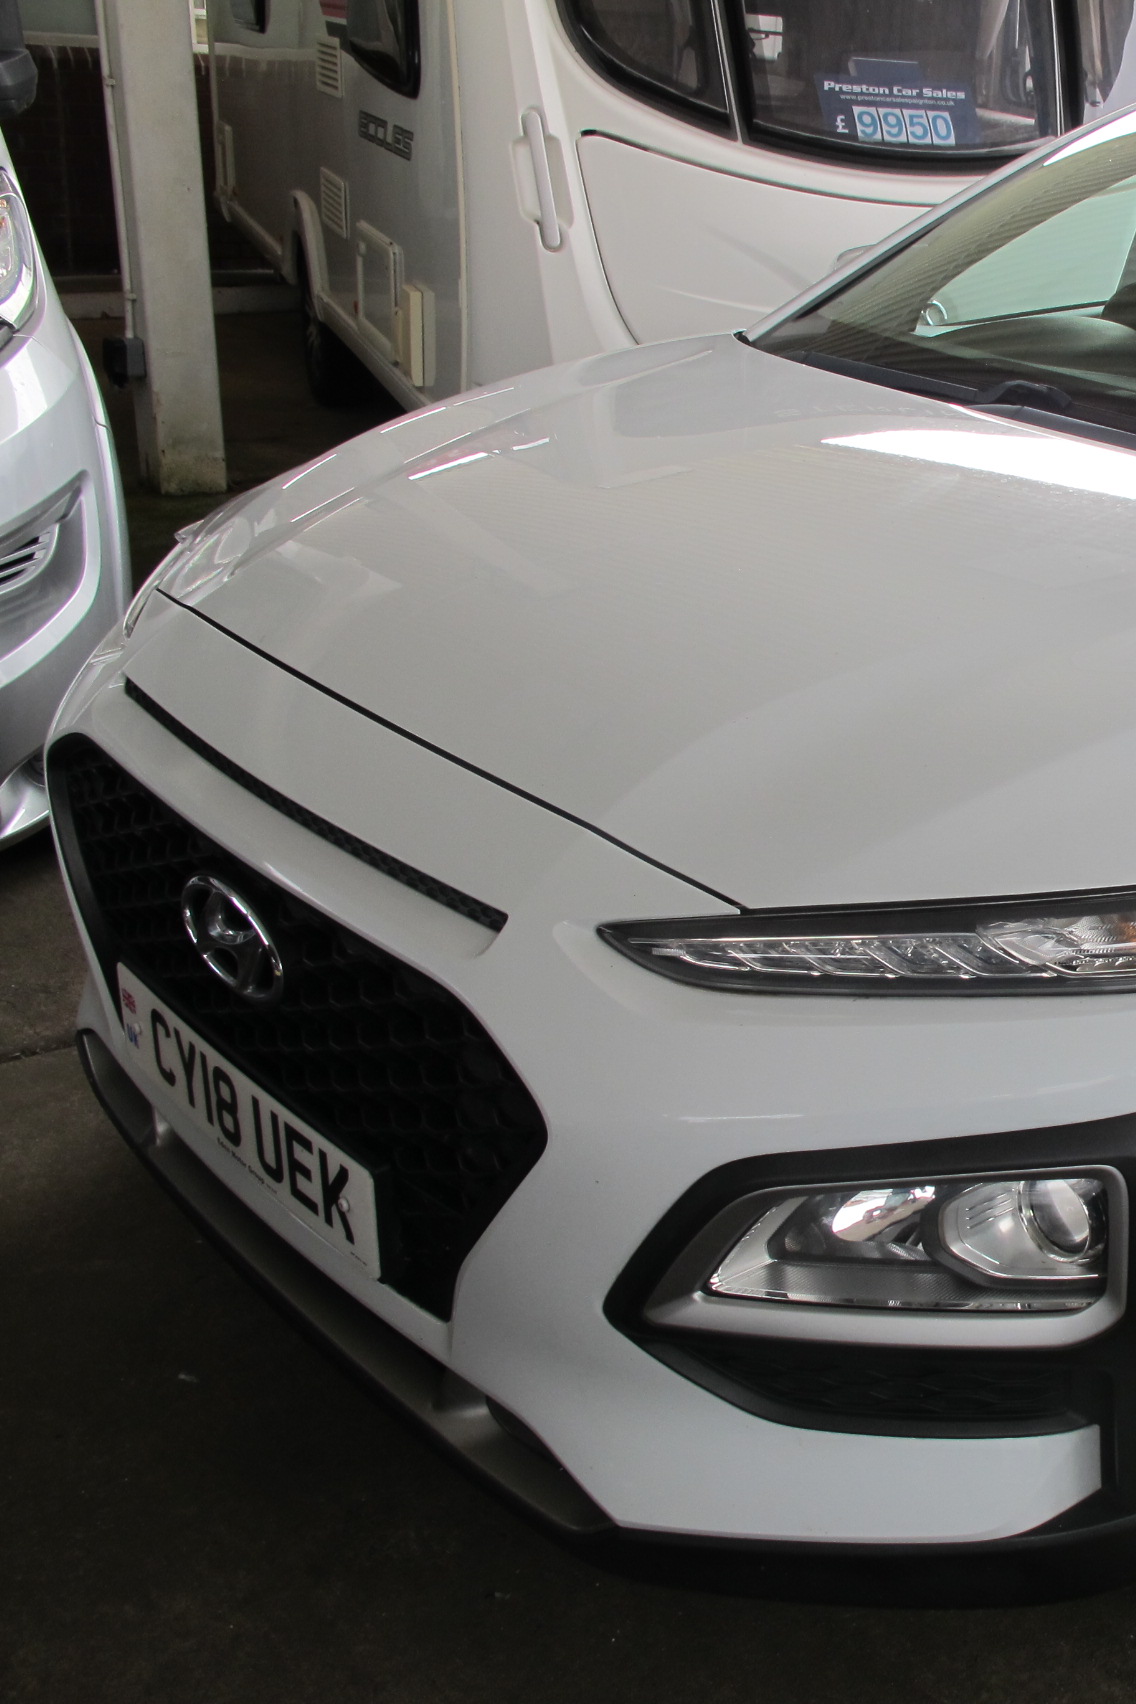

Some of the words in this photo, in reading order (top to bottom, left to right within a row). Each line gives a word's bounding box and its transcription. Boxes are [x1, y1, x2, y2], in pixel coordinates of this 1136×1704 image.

[823, 80, 890, 95] Preston
[892, 85, 920, 97] Car
[922, 87, 966, 100] Sales
[358, 109, 414, 161] ECCLES
[856, 110, 951, 141] 9950
[150, 1007, 242, 1148] CY18
[251, 1094, 355, 1246] UEK
